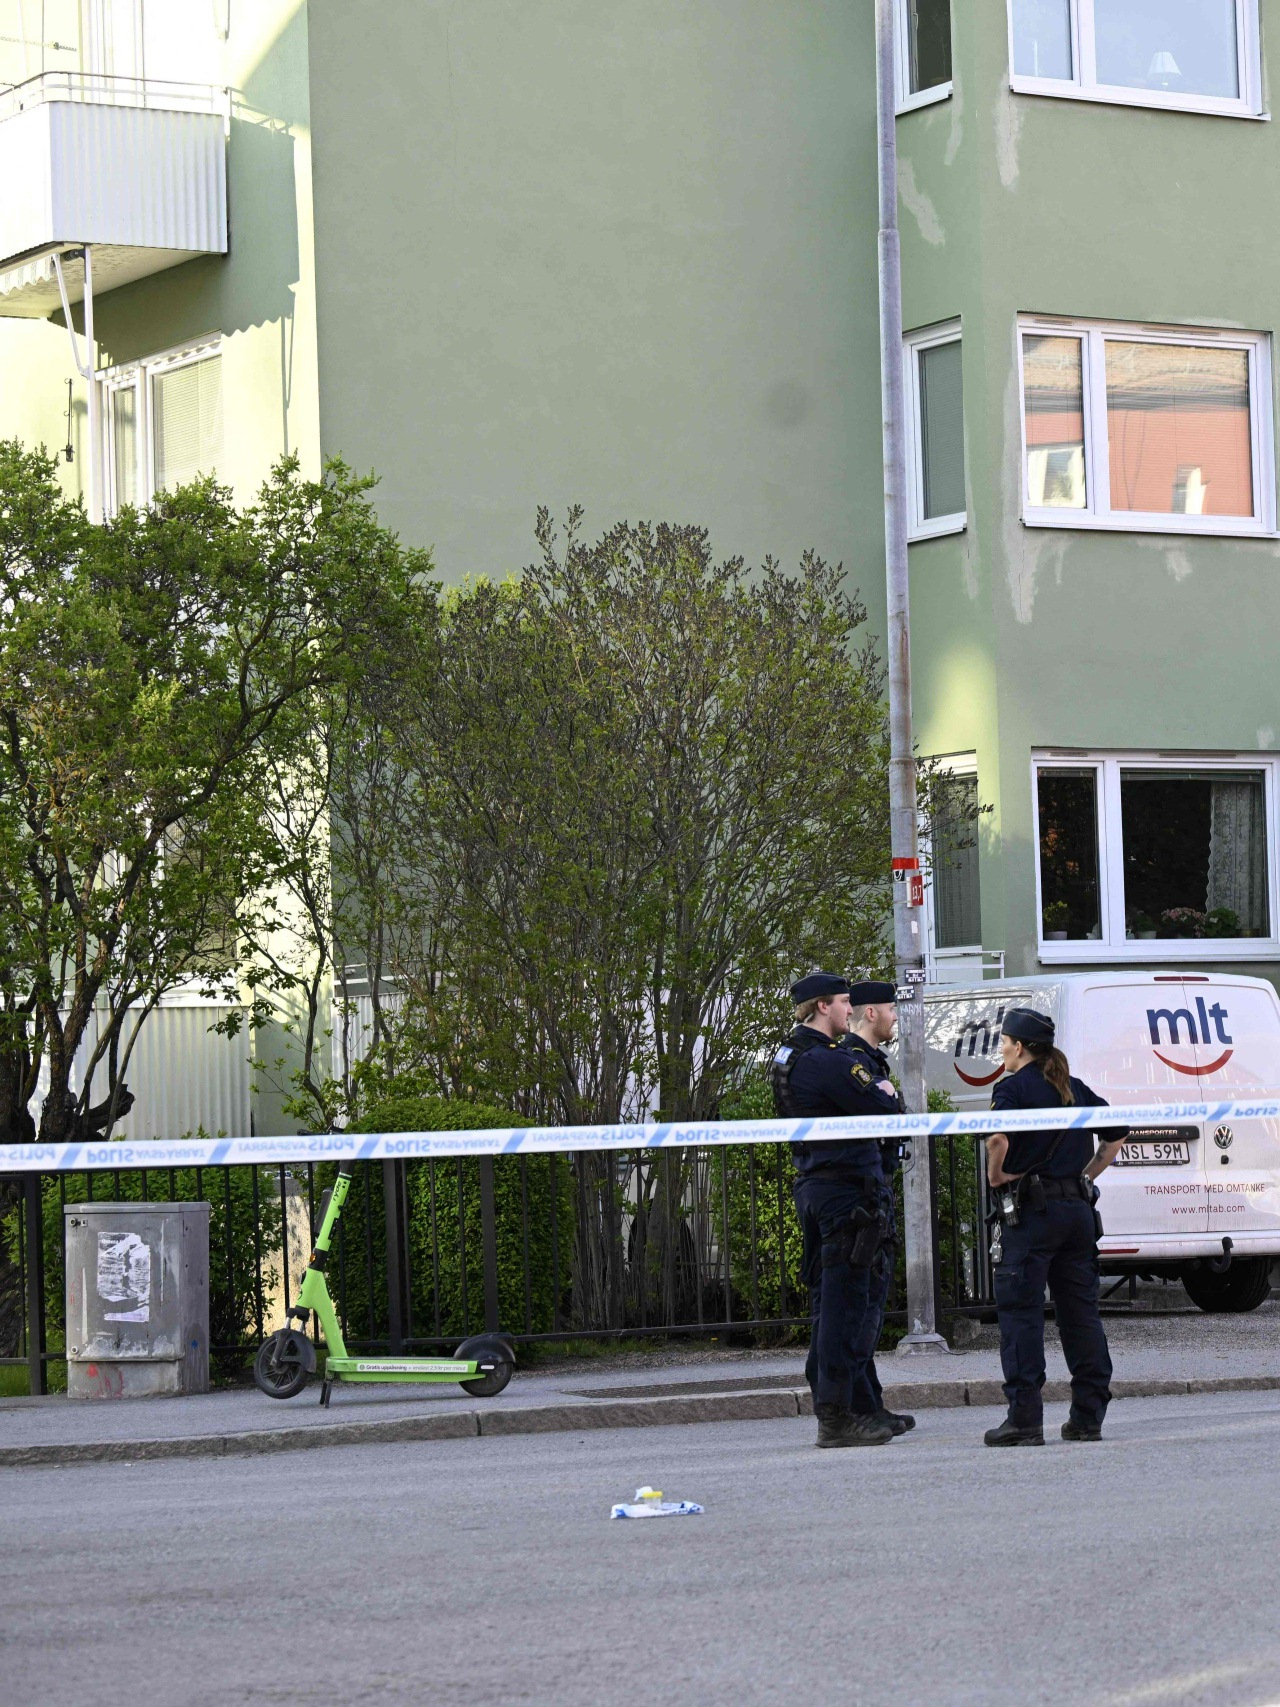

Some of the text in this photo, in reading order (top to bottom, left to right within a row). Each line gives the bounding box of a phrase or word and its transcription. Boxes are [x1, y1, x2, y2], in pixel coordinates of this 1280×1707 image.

[1146, 996, 1233, 1045] mlt
[954, 1006, 1005, 1057] ml
[1121, 1144, 1183, 1160] NSL 59M
[333, 1181, 342, 1201] ryde
[1144, 1183, 1265, 1195] TRANSPORT MED OMTANKE
[1172, 1204, 1246, 1214] www.mltab.com
